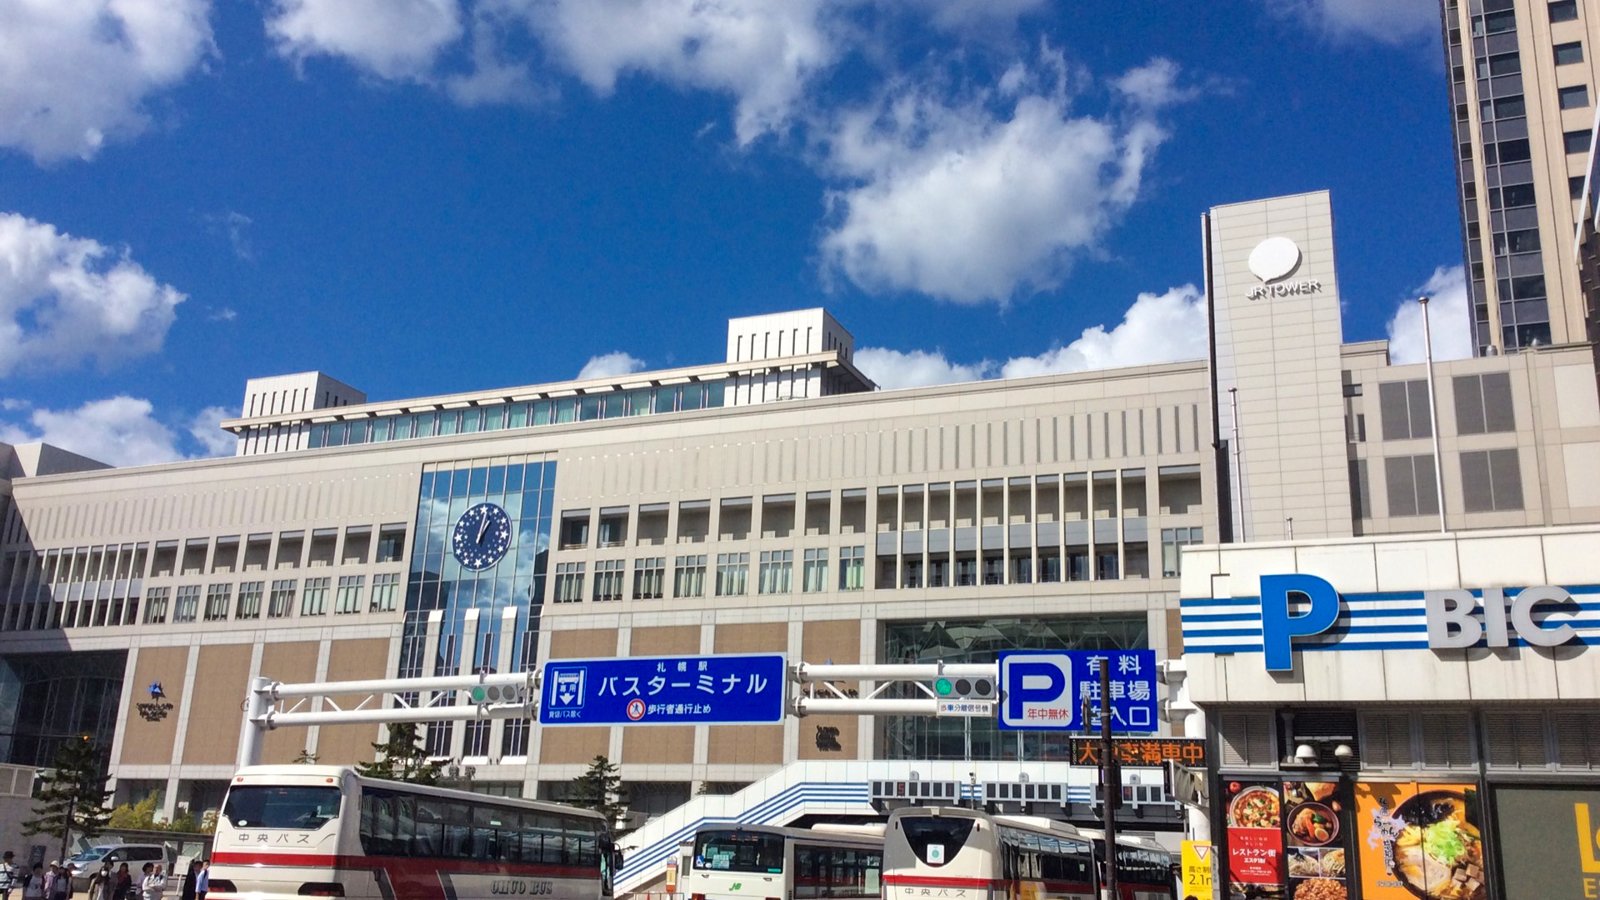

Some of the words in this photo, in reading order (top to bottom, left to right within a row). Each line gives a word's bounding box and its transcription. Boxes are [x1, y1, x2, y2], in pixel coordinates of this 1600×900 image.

[1246, 286, 1264, 299] JR
[1266, 280, 1321, 296] TOWER
[1259, 573, 1339, 671] P
[1424, 585, 1582, 649] BIC
[656, 660, 708, 673] 札幌駅
[1086, 655, 1141, 676] 有料
[560, 683, 577, 693] 専用
[597, 673, 768, 697] バスターミナル
[1009, 662, 1065, 720] P
[1079, 680, 1150, 701] 駐車場
[647, 703, 711, 716] 歩行者通行止め
[940, 703, 989, 713] 歩車分離信号機
[1027, 708, 1069, 719] 年中無休
[238, 833, 310, 844] 中央バス
[1574, 803, 1600, 873] L
[1232, 848, 1277, 857] レストラン街
[904, 887, 967, 898] 中央バス
[1583, 878, 1600, 898] E
